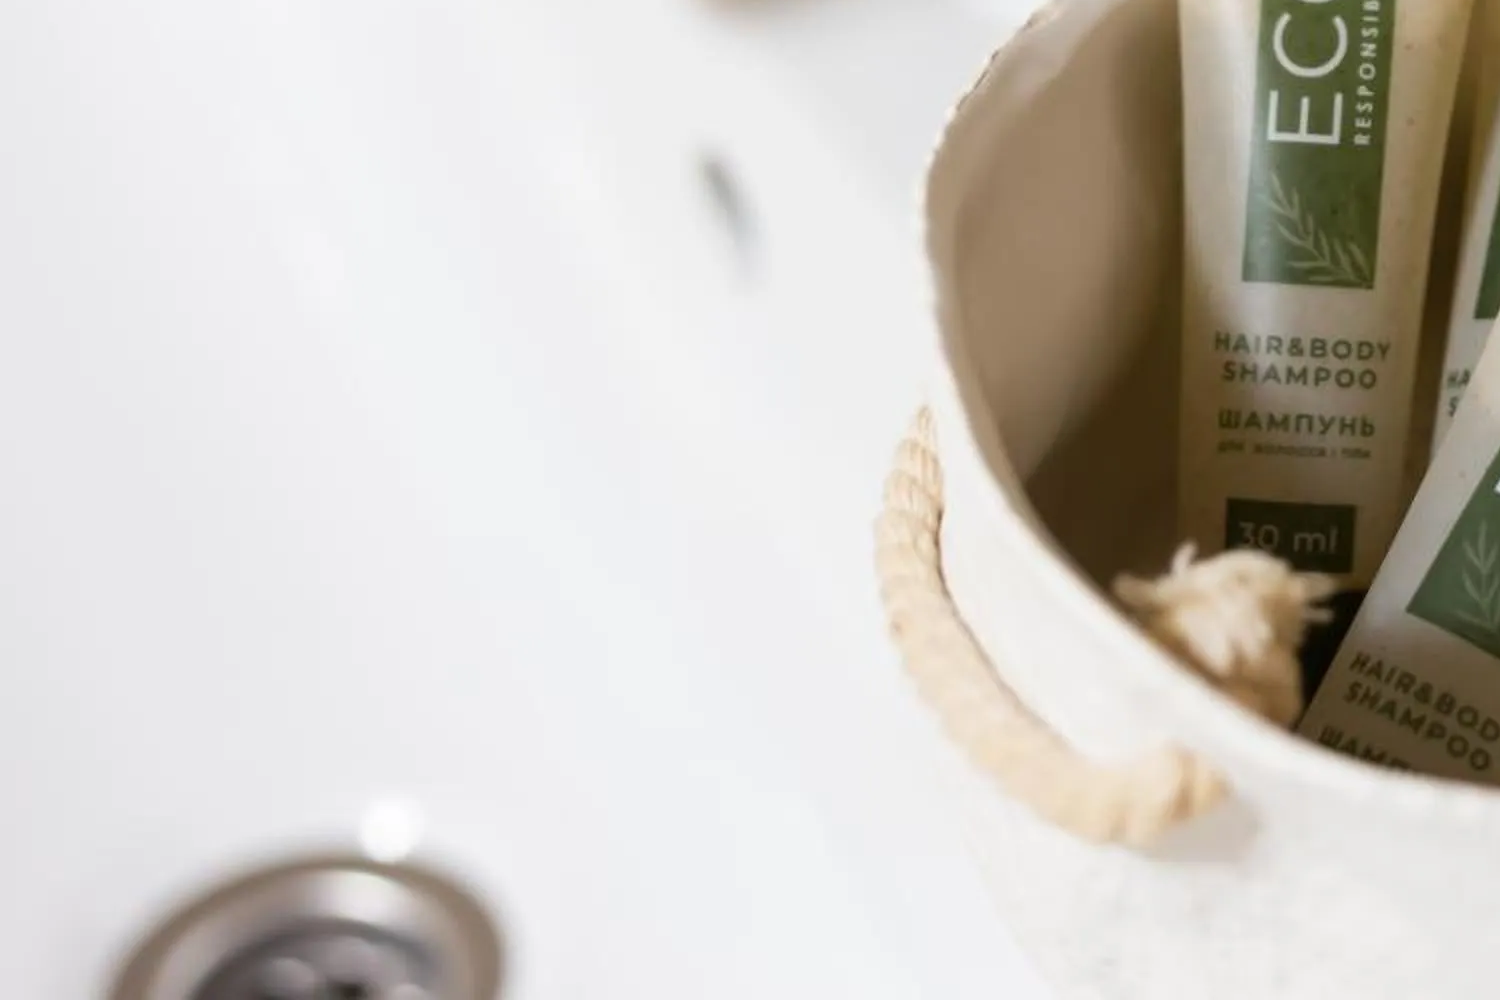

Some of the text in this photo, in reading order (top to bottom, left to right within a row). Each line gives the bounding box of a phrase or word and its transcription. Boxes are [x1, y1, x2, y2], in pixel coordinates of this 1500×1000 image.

[1214, 331, 1392, 363] HAIR&BODY
[1221, 359, 1378, 391] SHAMPOO
[1217, 409, 1376, 438] ШАМПУНЬ
[1293, 525, 1340, 554] ml
[1344, 680, 1492, 771] SHAMPOO
